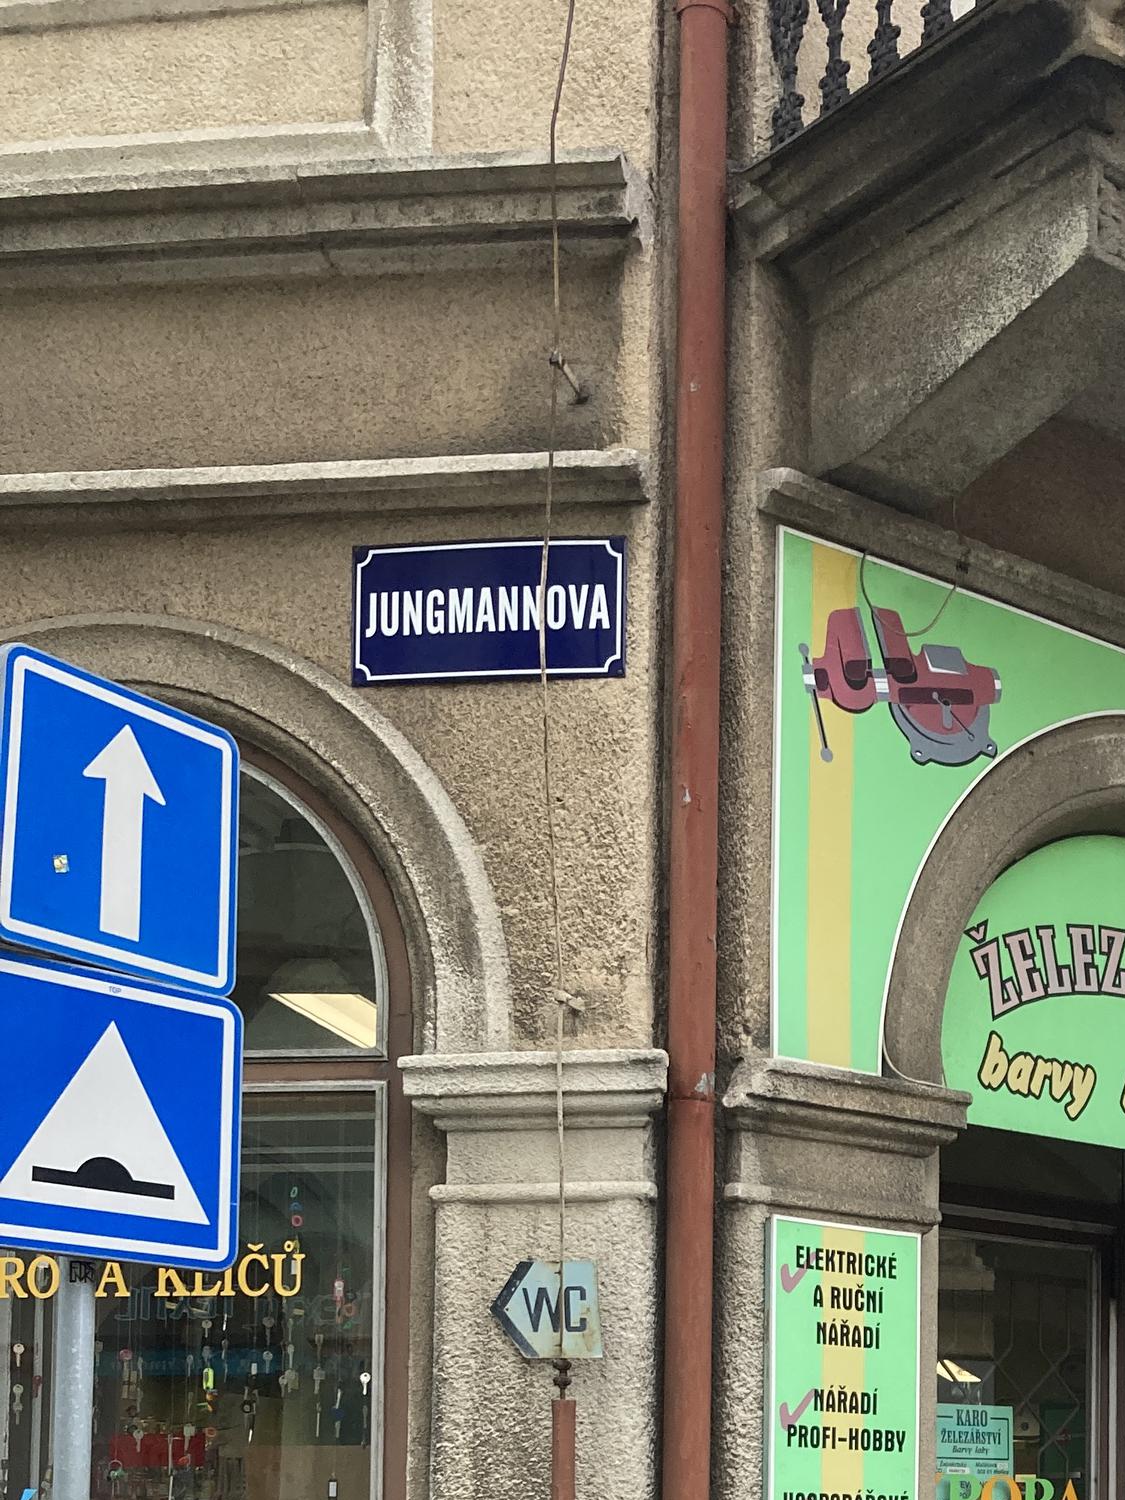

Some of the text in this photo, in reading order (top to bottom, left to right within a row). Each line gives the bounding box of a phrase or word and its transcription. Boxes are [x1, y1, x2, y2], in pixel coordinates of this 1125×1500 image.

[365, 583, 610, 638] JUNGMANNOVA
[978, 1030, 1096, 1121] barvy
[0, 1254, 131, 1299] ROA
[796, 1244, 897, 1280] ELEKTRICKÉ
[522, 1285, 587, 1333] WC
[813, 1283, 883, 1314] A RUČNÍ
[816, 1318, 880, 1349] NÁŘADÍ
[813, 1385, 878, 1415] NÁŘADÍ
[956, 1408, 988, 1427] KARO
[787, 1424, 906, 1452] PROFI-HOBBY
[940, 1427, 1002, 1446] ŽELEZÁŘSTVÍ
